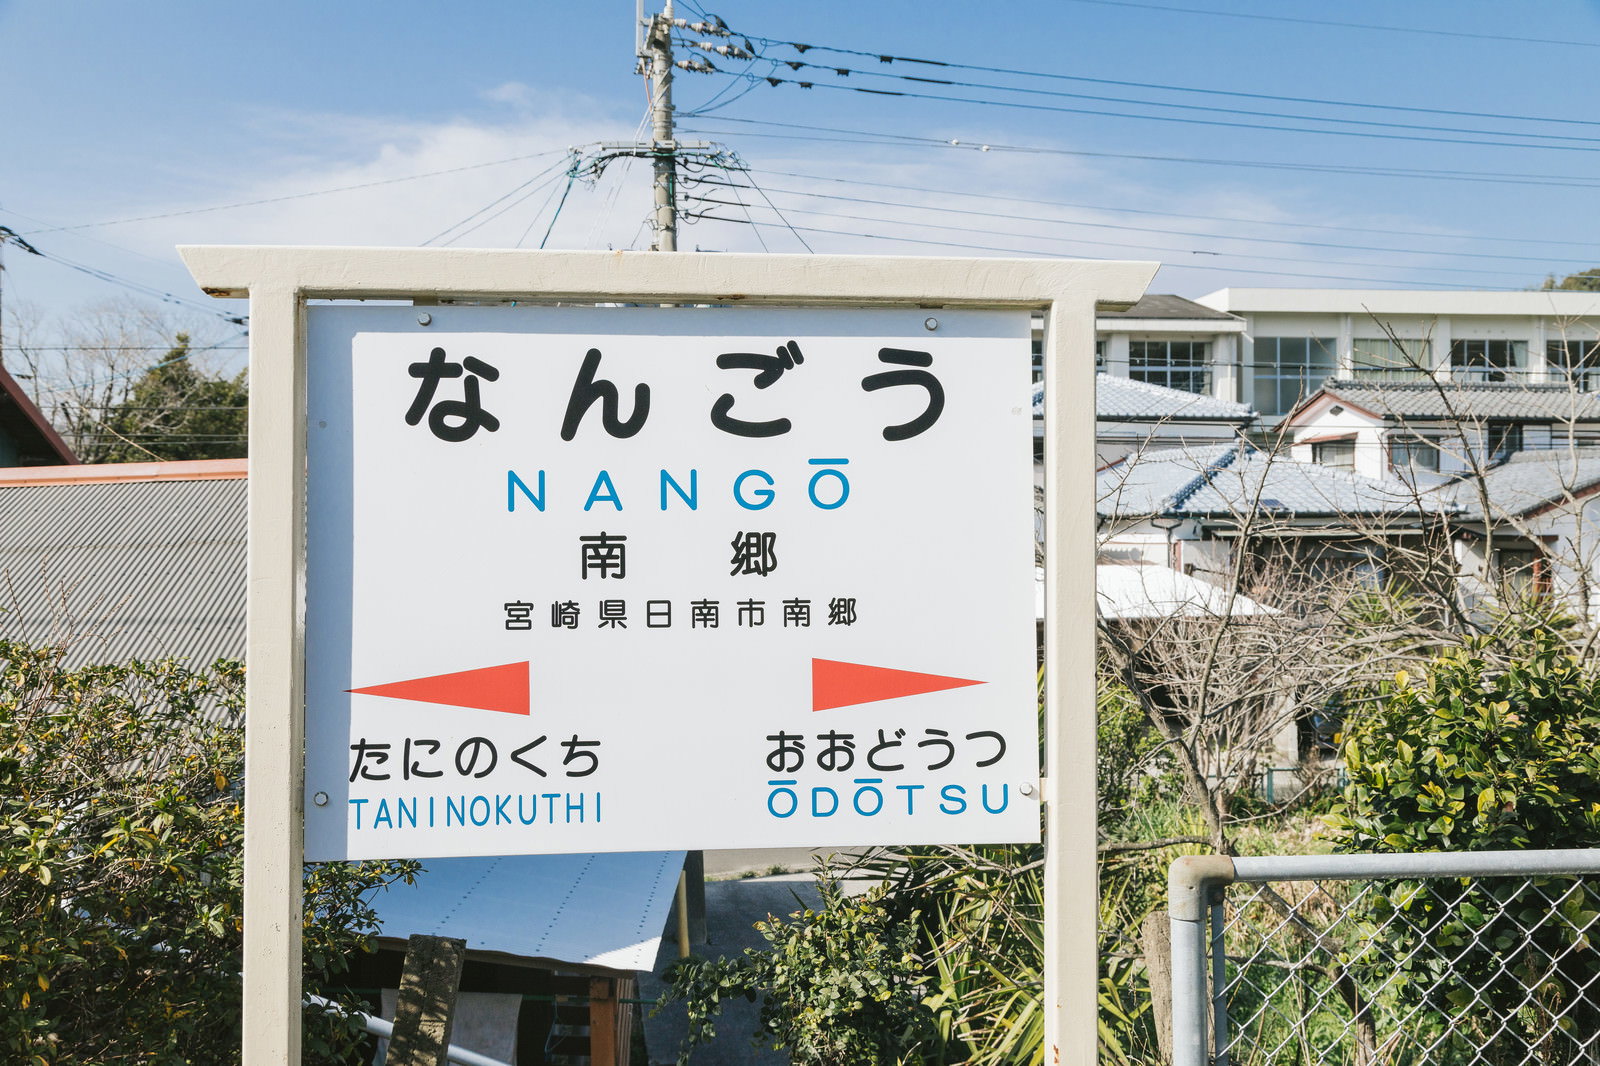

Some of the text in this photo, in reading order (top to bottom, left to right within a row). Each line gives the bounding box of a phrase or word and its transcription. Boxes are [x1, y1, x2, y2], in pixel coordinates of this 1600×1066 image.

[405, 341, 945, 442] なんごう
[508, 459, 850, 512] NANGŌ
[580, 530, 778, 580] 南郷
[504, 597, 857, 630] 宮崎県日南市南郷
[348, 734, 601, 782] たにのくち
[766, 728, 1007, 773] おおどうつ
[348, 792, 601, 830] TANINOKUTHI
[768, 778, 1009, 818] ŌDŌTSU
